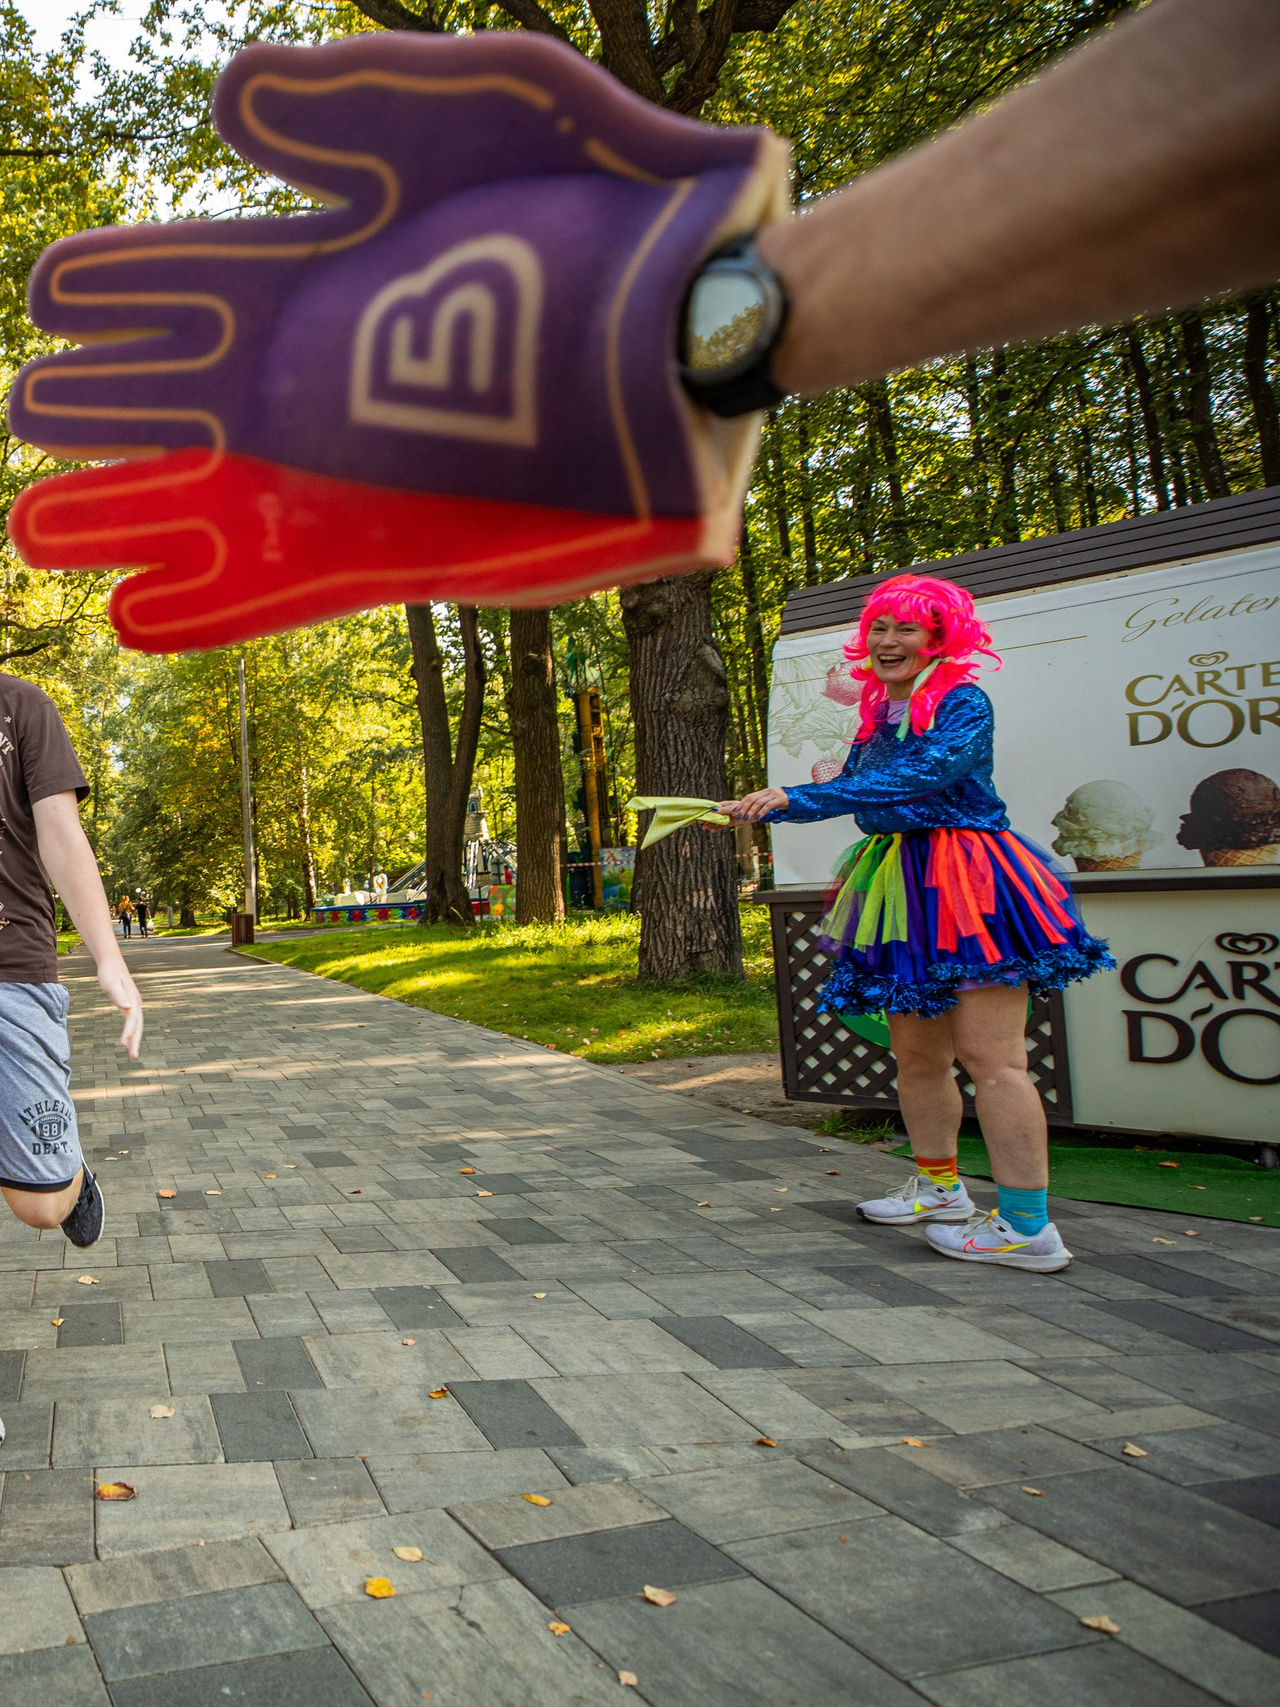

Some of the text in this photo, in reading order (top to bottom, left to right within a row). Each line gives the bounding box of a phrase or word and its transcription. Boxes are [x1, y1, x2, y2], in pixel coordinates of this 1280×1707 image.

[1120, 953, 1280, 1008] CAR
[42, 1123, 58, 1137] 98
[32, 1141, 73, 1155] DEPT.
